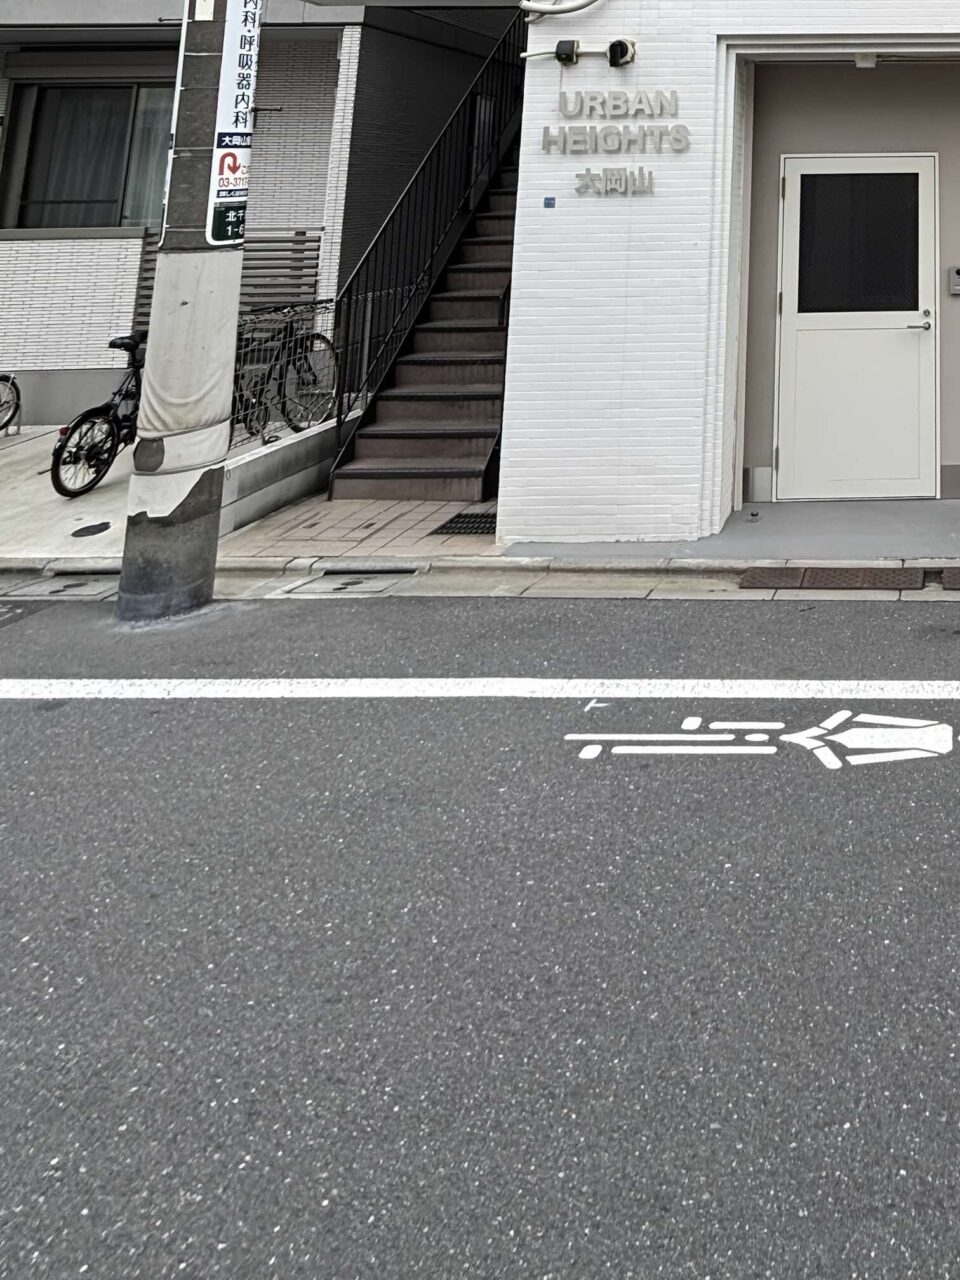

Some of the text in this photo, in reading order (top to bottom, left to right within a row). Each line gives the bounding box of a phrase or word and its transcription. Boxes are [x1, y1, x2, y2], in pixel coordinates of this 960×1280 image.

[559, 90, 678, 118] URBAN
[542, 124, 690, 153] HEIGHTS
[575, 167, 653, 194] 大岡山
